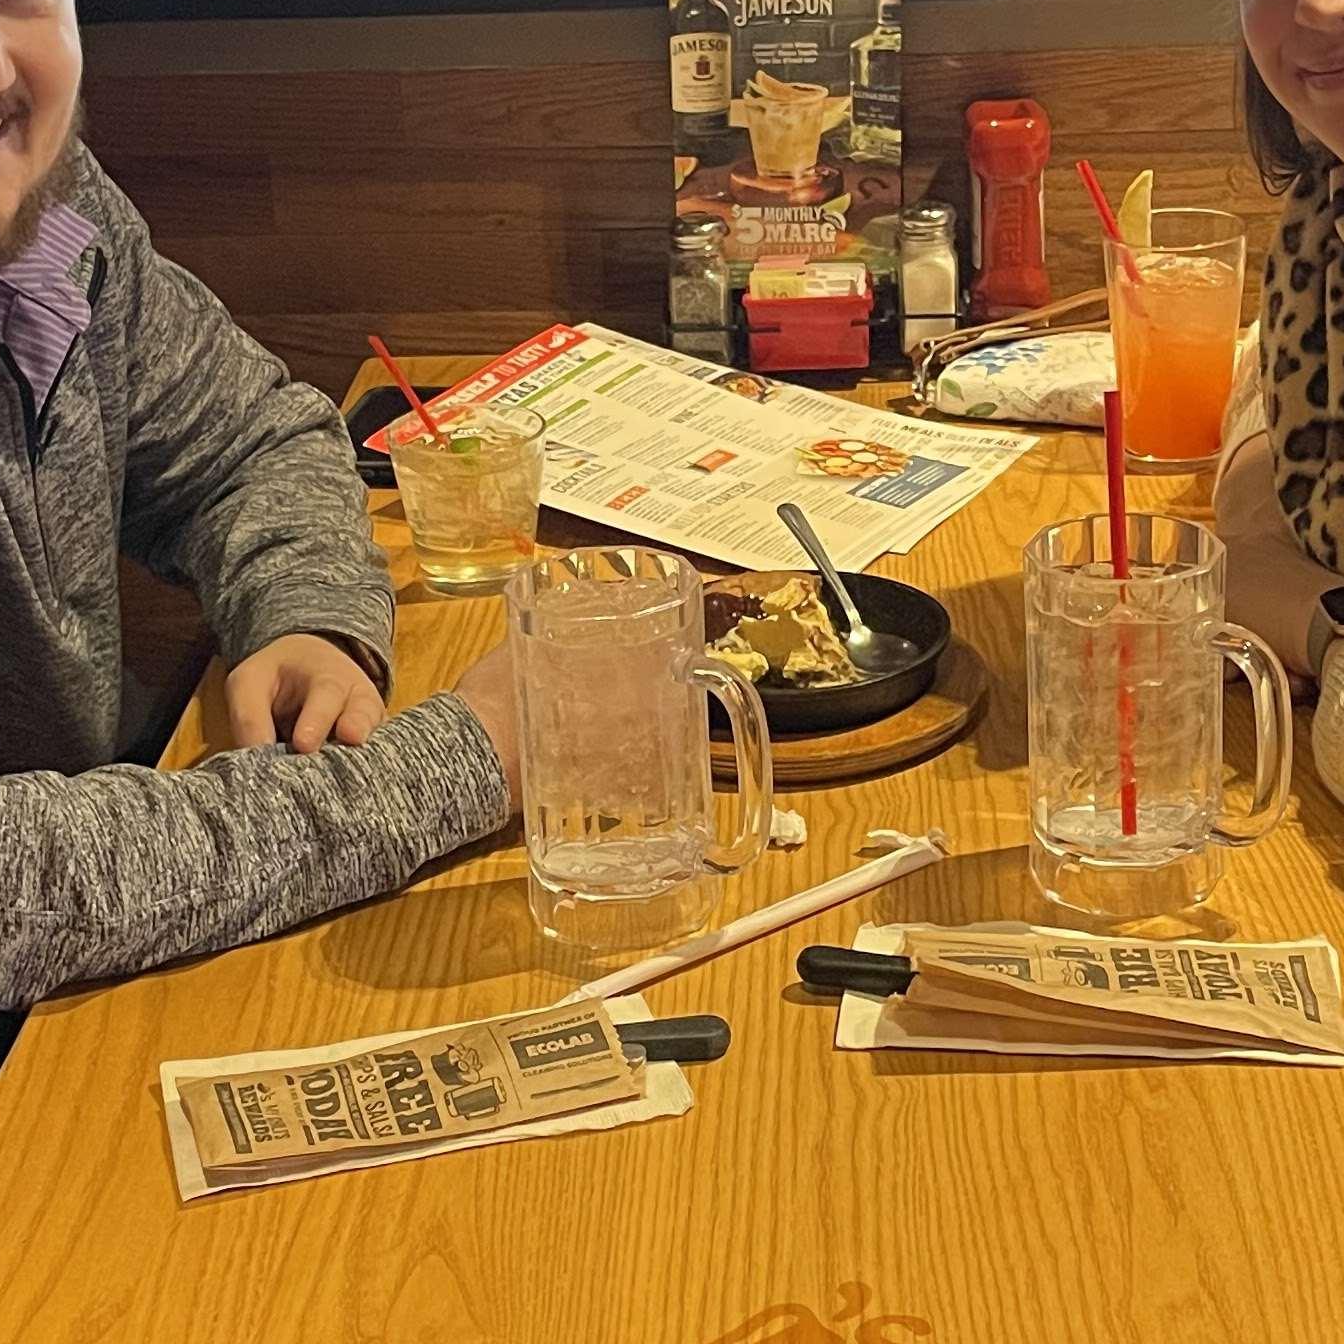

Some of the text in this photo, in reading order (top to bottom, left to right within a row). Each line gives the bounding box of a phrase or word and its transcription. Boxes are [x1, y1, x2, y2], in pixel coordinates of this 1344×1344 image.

[764, 206, 822, 223] MONTHLY
[732, 204, 764, 244] $5
[765, 223, 837, 243] MARG
[507, 343, 550, 368] TASTY
[901, 425, 944, 438] MEALS
[978, 437, 1021, 448] DEALS
[541, 1016, 582, 1031] PARTNER
[525, 1032, 594, 1057] ECOLAB
[522, 1063, 565, 1078] CLEANING
[361, 1087, 380, 1100] &
